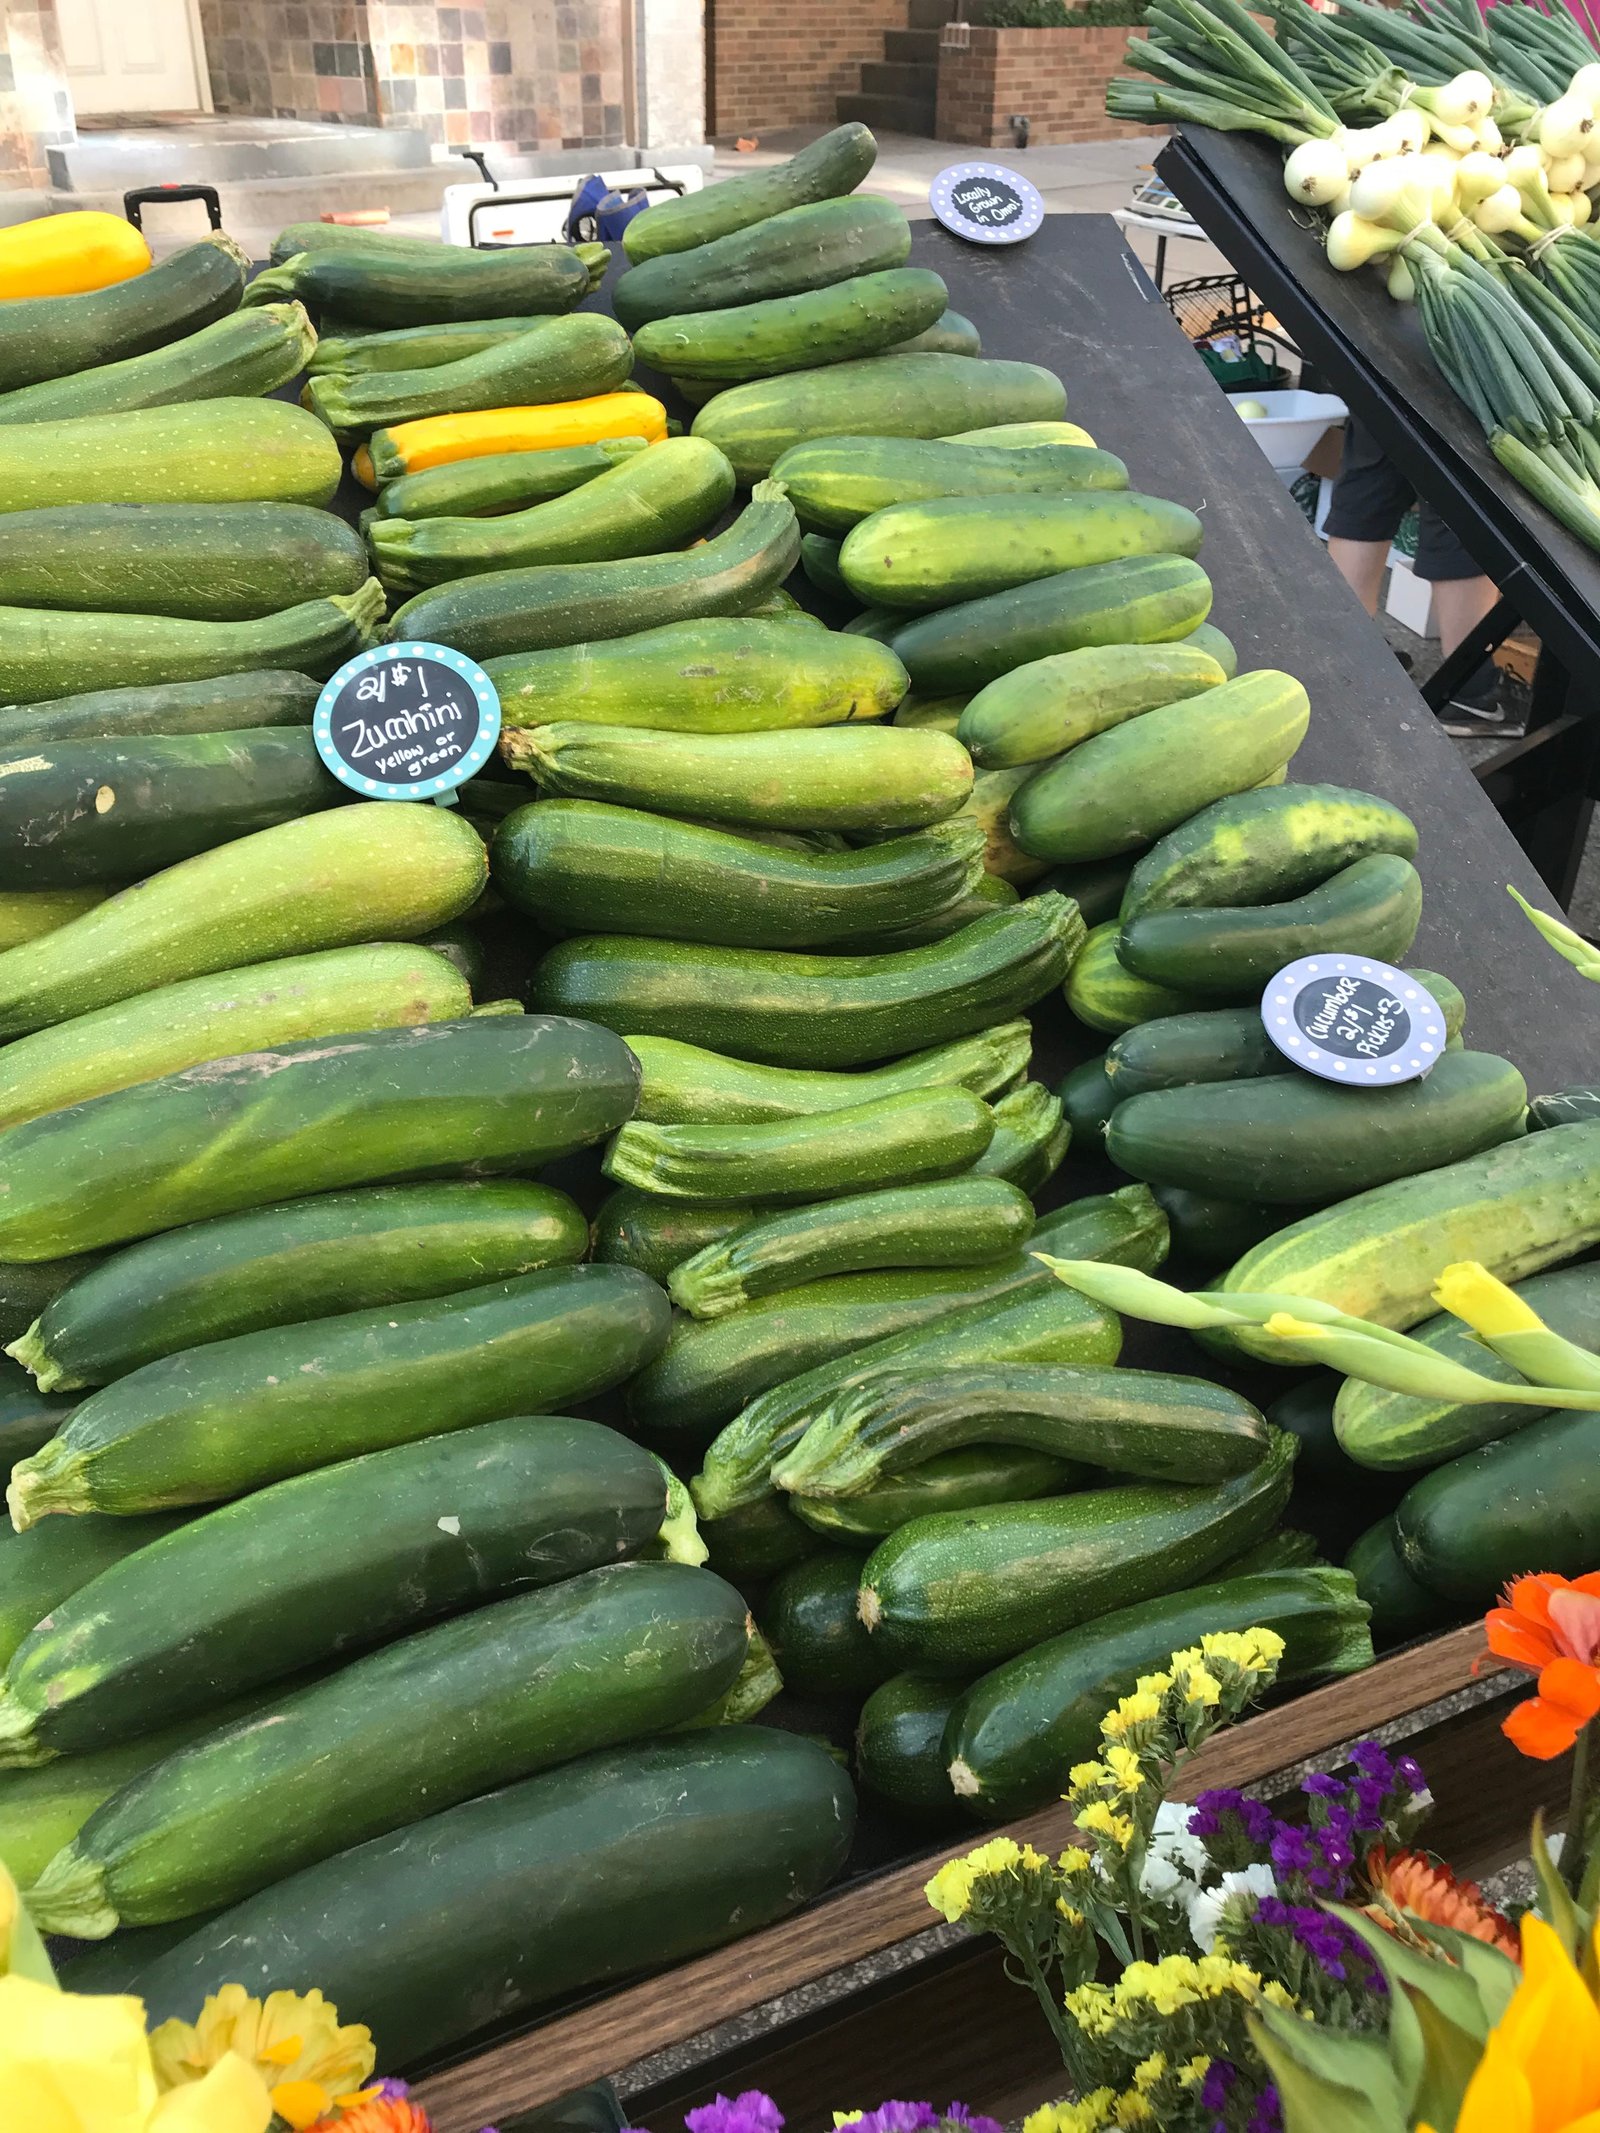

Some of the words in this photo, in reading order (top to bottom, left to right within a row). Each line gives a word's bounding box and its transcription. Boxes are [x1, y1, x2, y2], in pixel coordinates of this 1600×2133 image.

[954, 186, 991, 204] Locally
[969, 196, 1003, 213] Grown
[976, 214, 990, 223] in
[342, 692, 462, 758] Zucchini
[436, 732, 455, 746] or
[408, 744, 462, 777] green
[1356, 1015, 1395, 1058] Pickles
